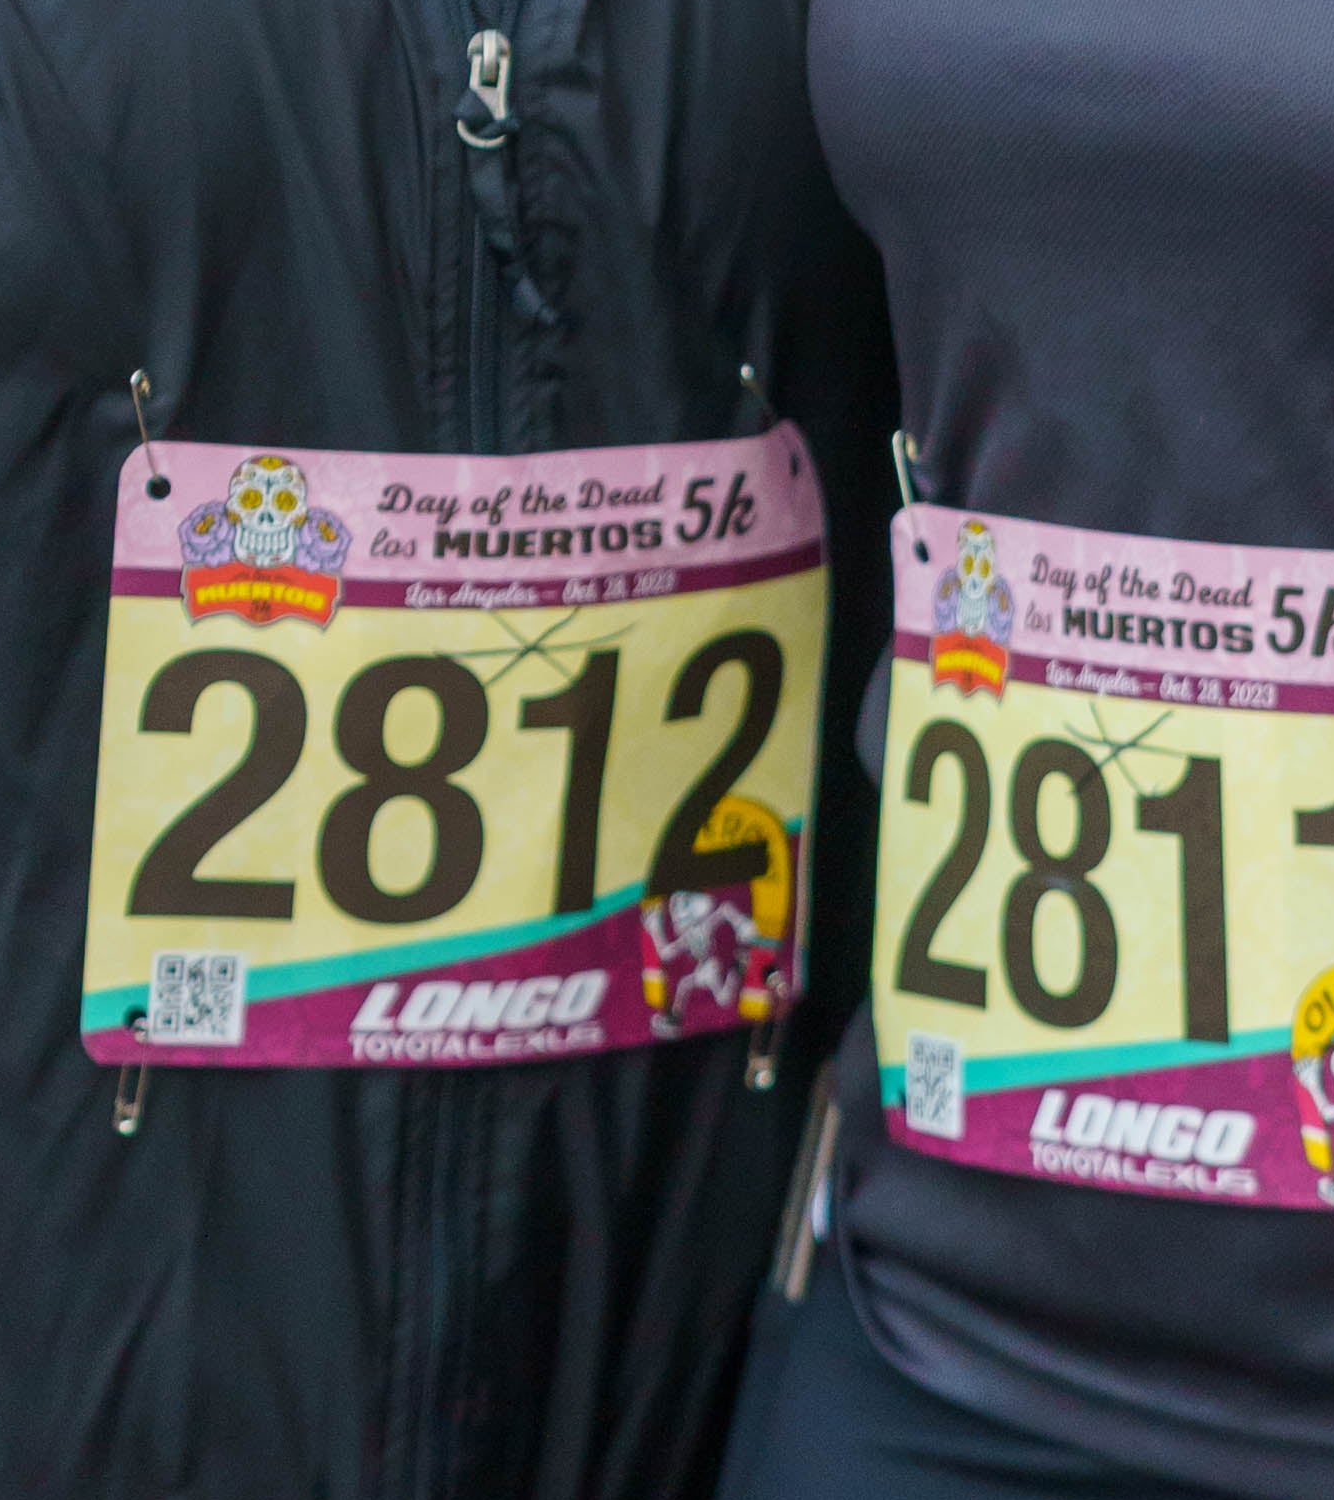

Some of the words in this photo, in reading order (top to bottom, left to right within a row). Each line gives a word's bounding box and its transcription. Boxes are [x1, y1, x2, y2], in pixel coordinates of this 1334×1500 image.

[376, 482, 459, 525] Day
[470, 487, 513, 525] of
[521, 483, 566, 514] the
[577, 473, 666, 510] Dead
[675, 471, 757, 543] 5k
[369, 526, 417, 558] los
[432, 518, 665, 559] MUERTOS
[404, 580, 447, 608] Los
[449, 579, 539, 610] Angeles
[1029, 552, 1078, 600] Day
[1084, 564, 1113, 606] of
[1119, 565, 1161, 599] the
[1169, 571, 1254, 608] Dead
[1024, 600, 1052, 632] los
[1062, 607, 1255, 654] MUERTOS
[1046, 658, 1074, 689] Los
[1075, 662, 1142, 697] Angeles
[1228, 680, 1280, 709] 2023
[125, 628, 784, 925] 2812
[350, 969, 608, 1032] LONGO
[348, 1031, 466, 1062] TOYOTA
[467, 1020, 606, 1060] LEXUS
[1030, 1088, 1257, 1167] LONGO
[1029, 1141, 1121, 1180] TOYOTA
[1121, 1155, 1259, 1197] LEXUS
